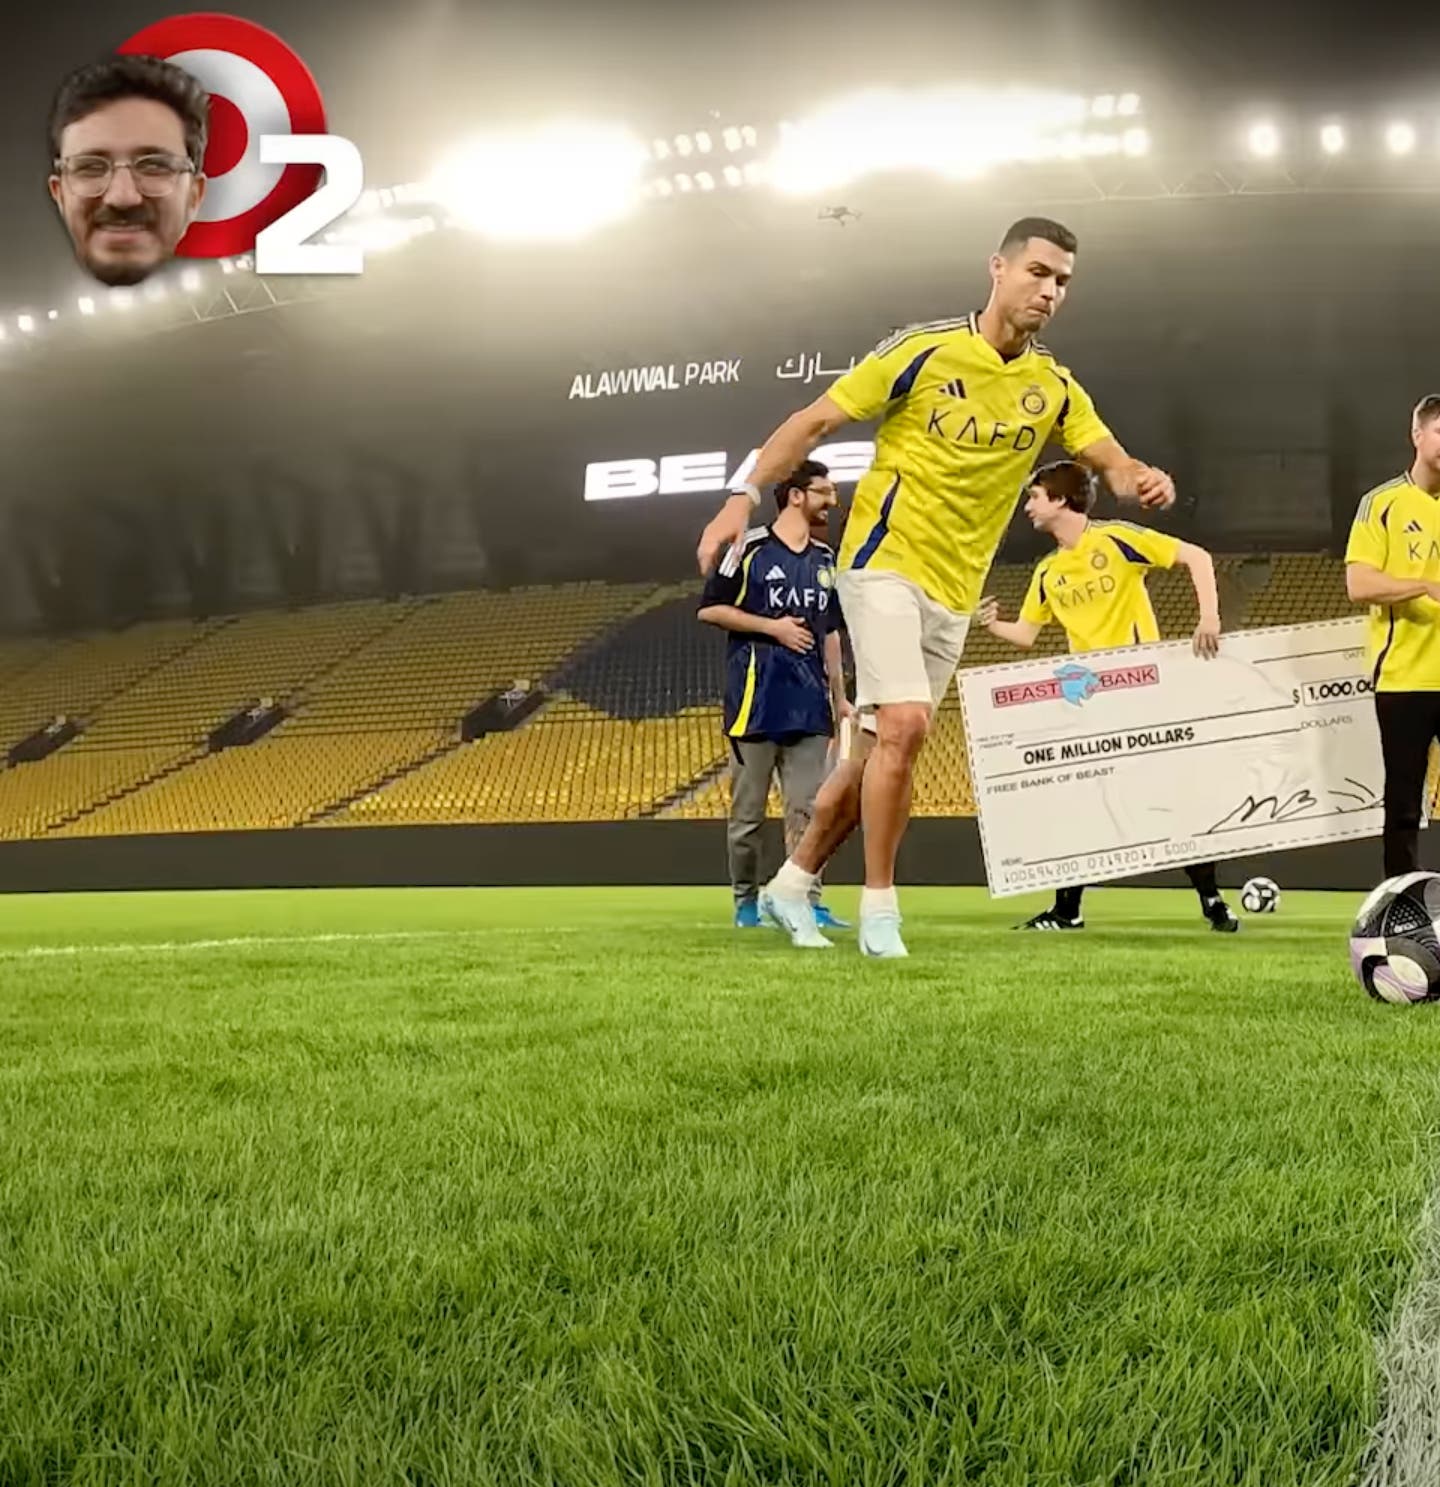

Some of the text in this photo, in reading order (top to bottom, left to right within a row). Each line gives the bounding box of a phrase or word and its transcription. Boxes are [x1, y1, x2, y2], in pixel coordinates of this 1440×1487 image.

[568, 358, 742, 400] ALAWWAL PARK
[927, 408, 1036, 451] KAFD
[768, 586, 829, 611] KAFD
[1056, 575, 1116, 610] KAFD
[994, 668, 1156, 705] BEAST BANK
[1023, 726, 1196, 765] ONE MILLION DOLLARS
[1020, 775, 1055, 789] BANK
[1056, 772, 1073, 783] OF
[1075, 766, 1115, 781] BEAST
